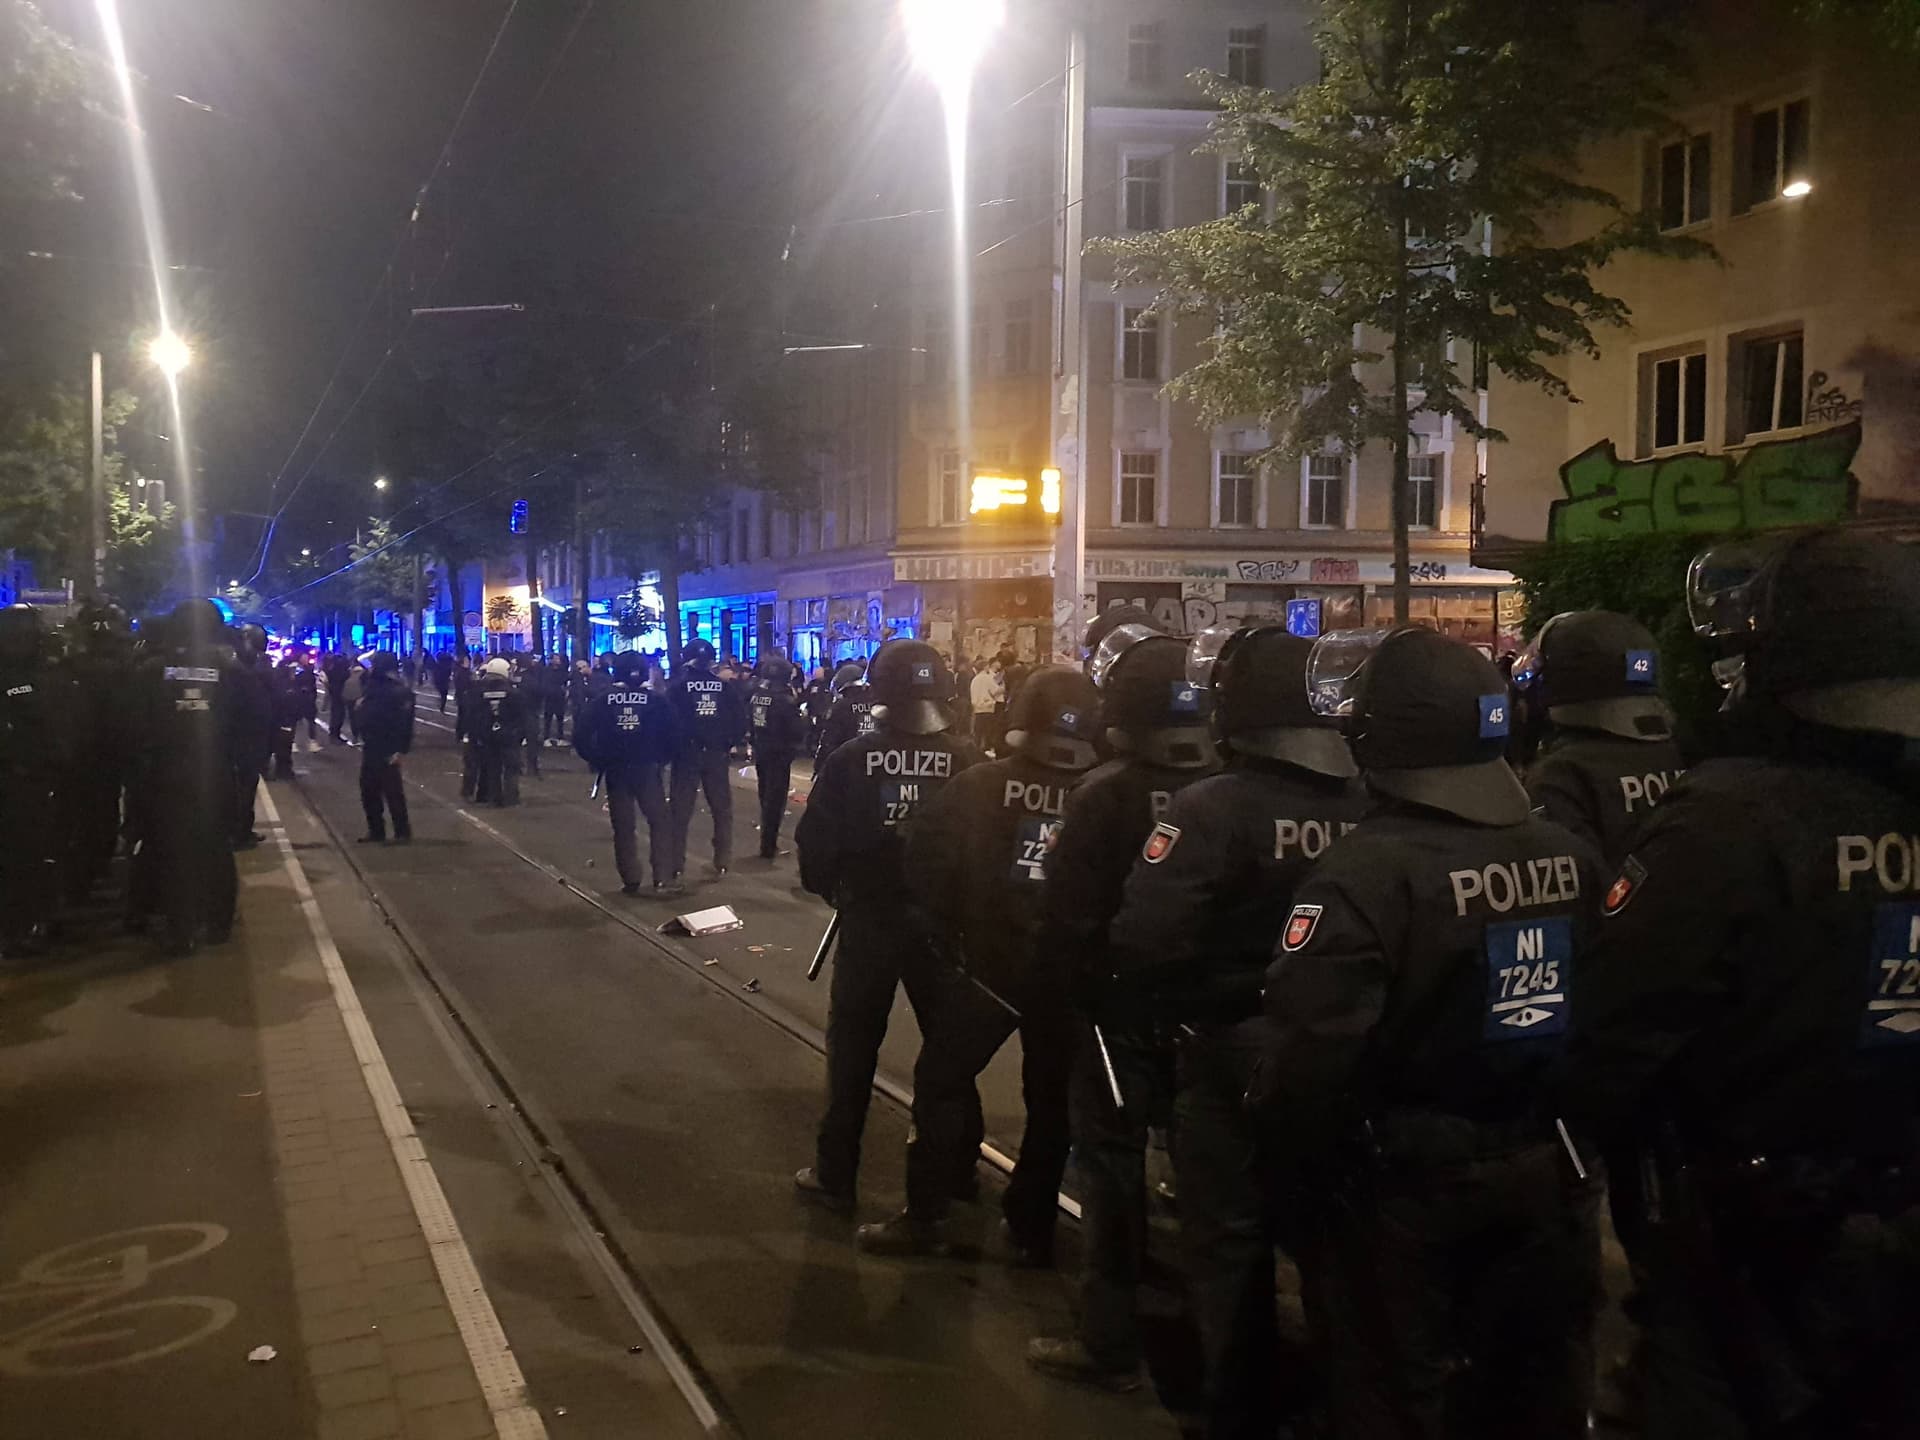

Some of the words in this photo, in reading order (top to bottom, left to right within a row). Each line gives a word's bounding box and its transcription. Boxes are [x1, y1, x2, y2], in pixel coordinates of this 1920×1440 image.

[918, 668, 930, 678] 43
[1634, 659, 1649, 672] 42
[687, 681, 723, 693] POLIZEI
[607, 692, 648, 705] POLIZEI
[851, 703, 871, 714] POLI
[1489, 707, 1504, 724] 45
[866, 750, 952, 778] POLIZEI
[899, 784, 919, 801] NI
[1003, 779, 1069, 816] POLI
[886, 802, 910, 820] 72
[1023, 840, 1049, 861] 72
[1449, 855, 1580, 916] POLIZEI
[1516, 928, 1544, 961] NI
[1500, 960, 1560, 998] 7245
